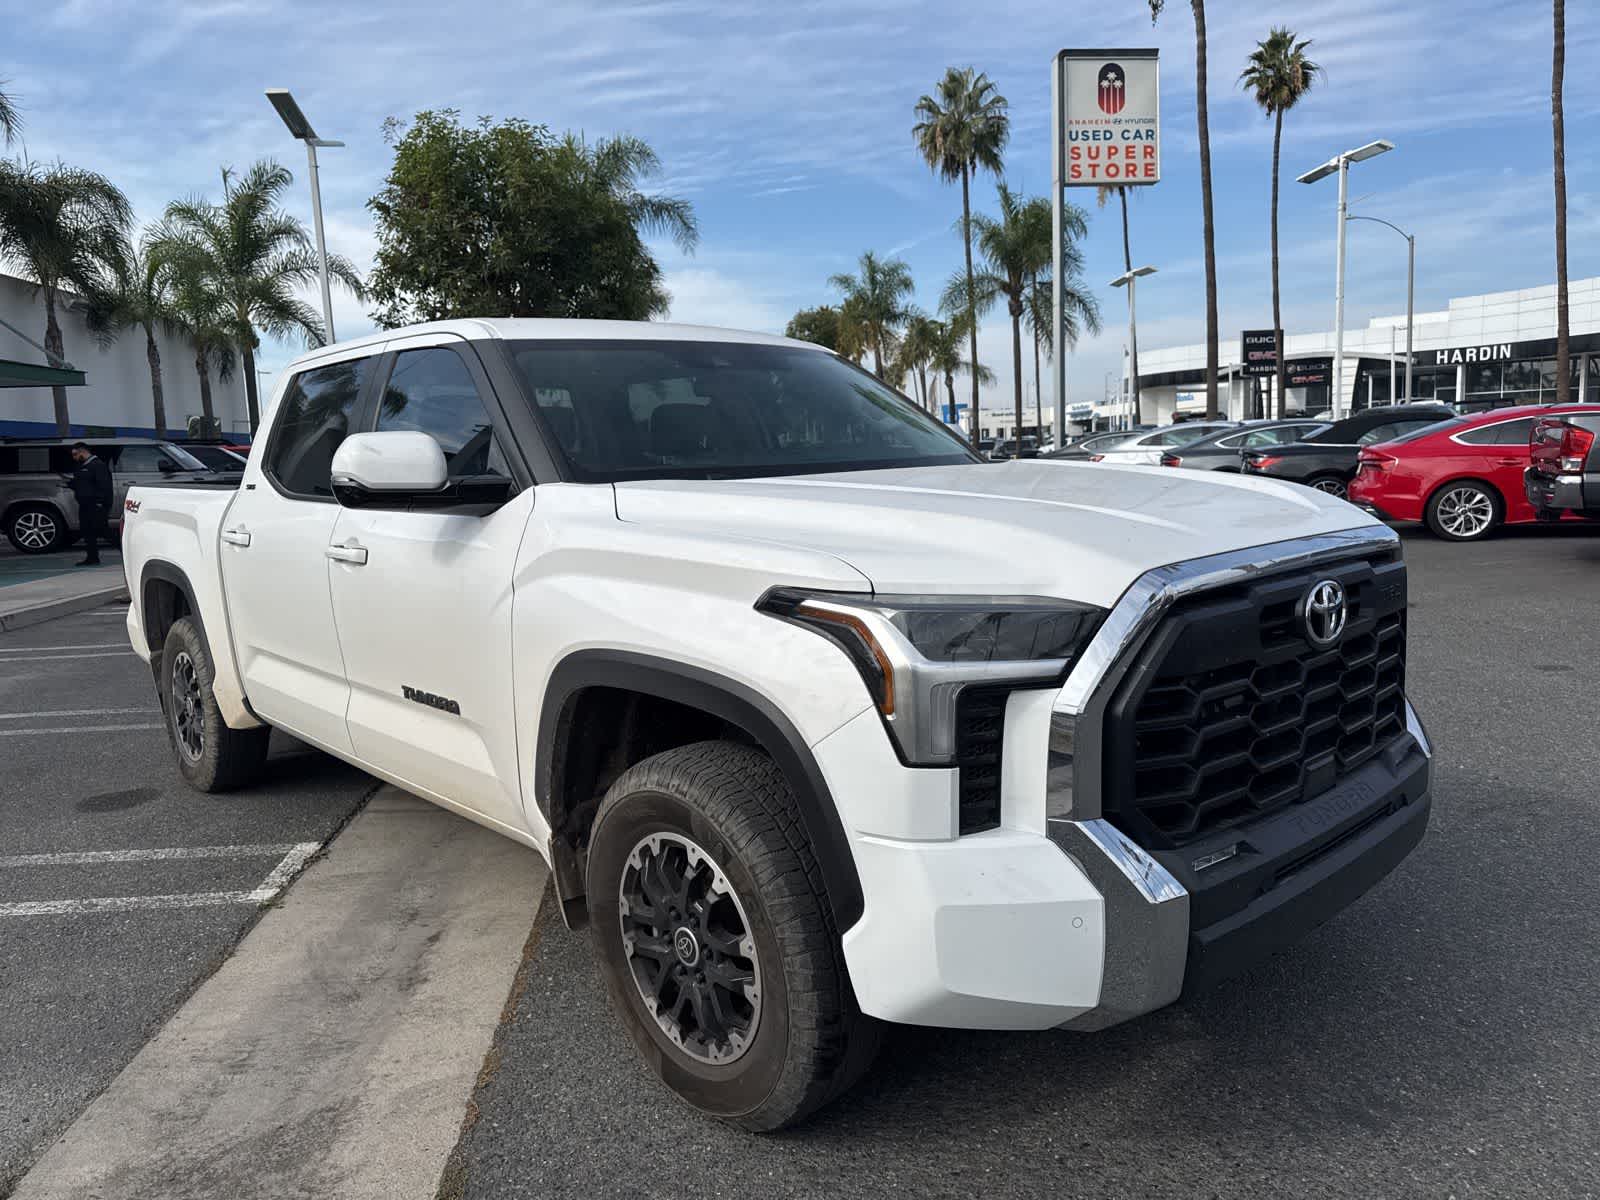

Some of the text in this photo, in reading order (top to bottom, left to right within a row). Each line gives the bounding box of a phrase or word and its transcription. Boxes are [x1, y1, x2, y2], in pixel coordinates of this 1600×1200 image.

[1068, 129, 1155, 141] USED CAR
[1070, 145, 1155, 160] SUPER
[1070, 163, 1155, 179] STORE
[1248, 351, 1277, 360] GMC
[1436, 344, 1512, 365] HARDIN
[1291, 375, 1324, 383] GMC
